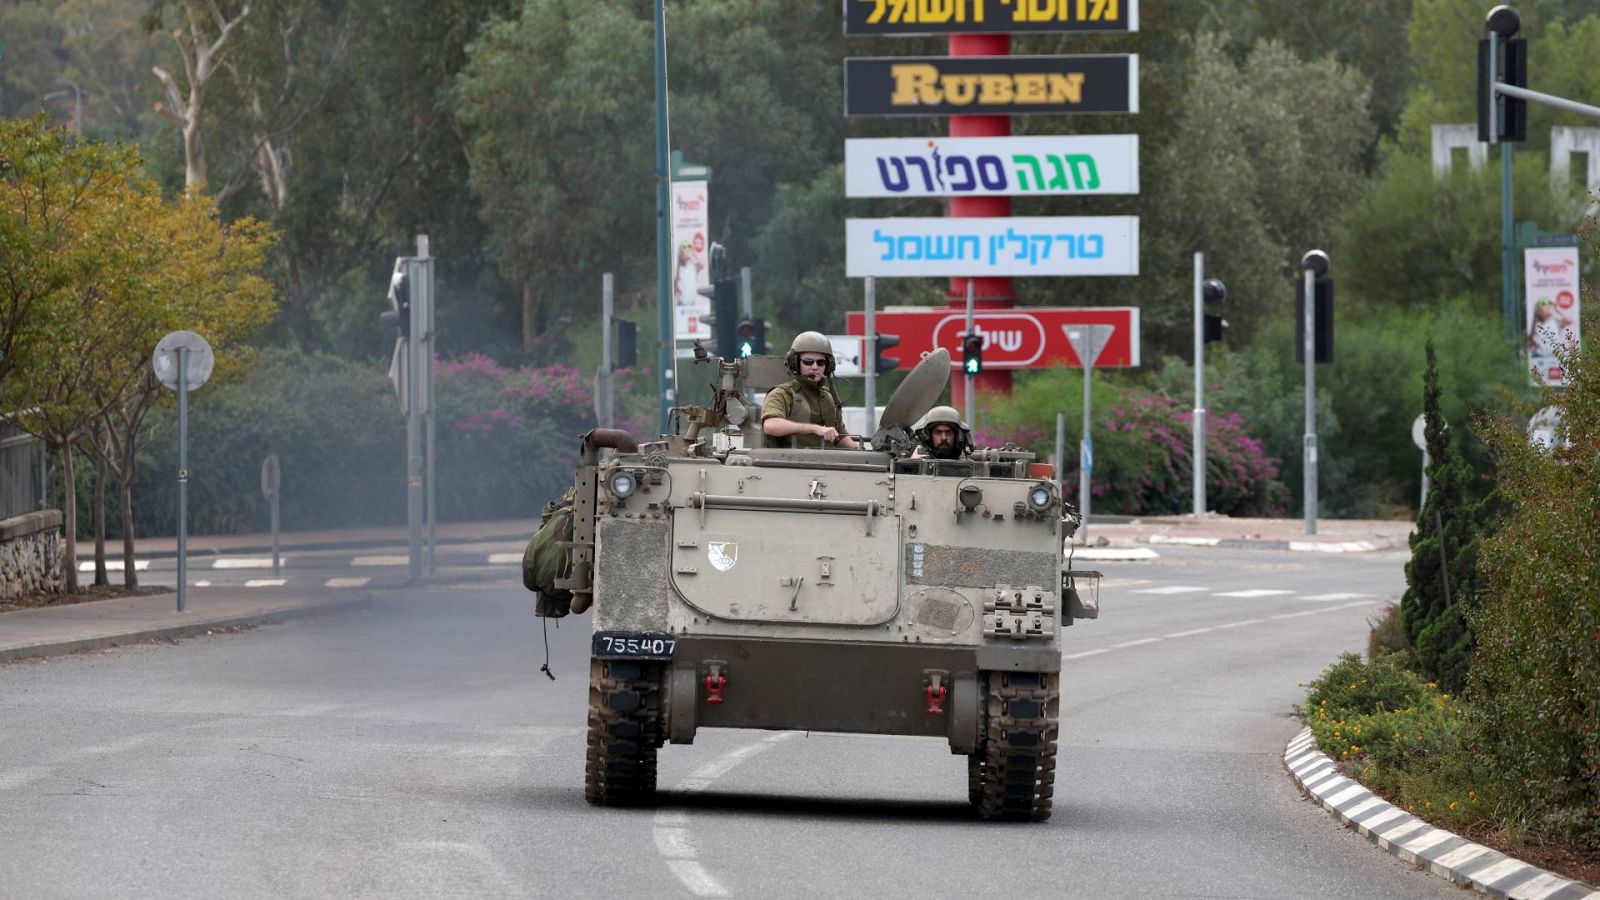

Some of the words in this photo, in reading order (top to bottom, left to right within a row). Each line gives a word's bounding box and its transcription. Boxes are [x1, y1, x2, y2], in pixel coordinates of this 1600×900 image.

[857, 0, 985, 24] חשמל
[876, 146, 1008, 192] ספורט
[1011, 153, 1101, 191] מגה
[873, 229, 982, 262] חשמל
[986, 228, 1104, 266] טרקלין
[602, 636, 676, 655] 755407
